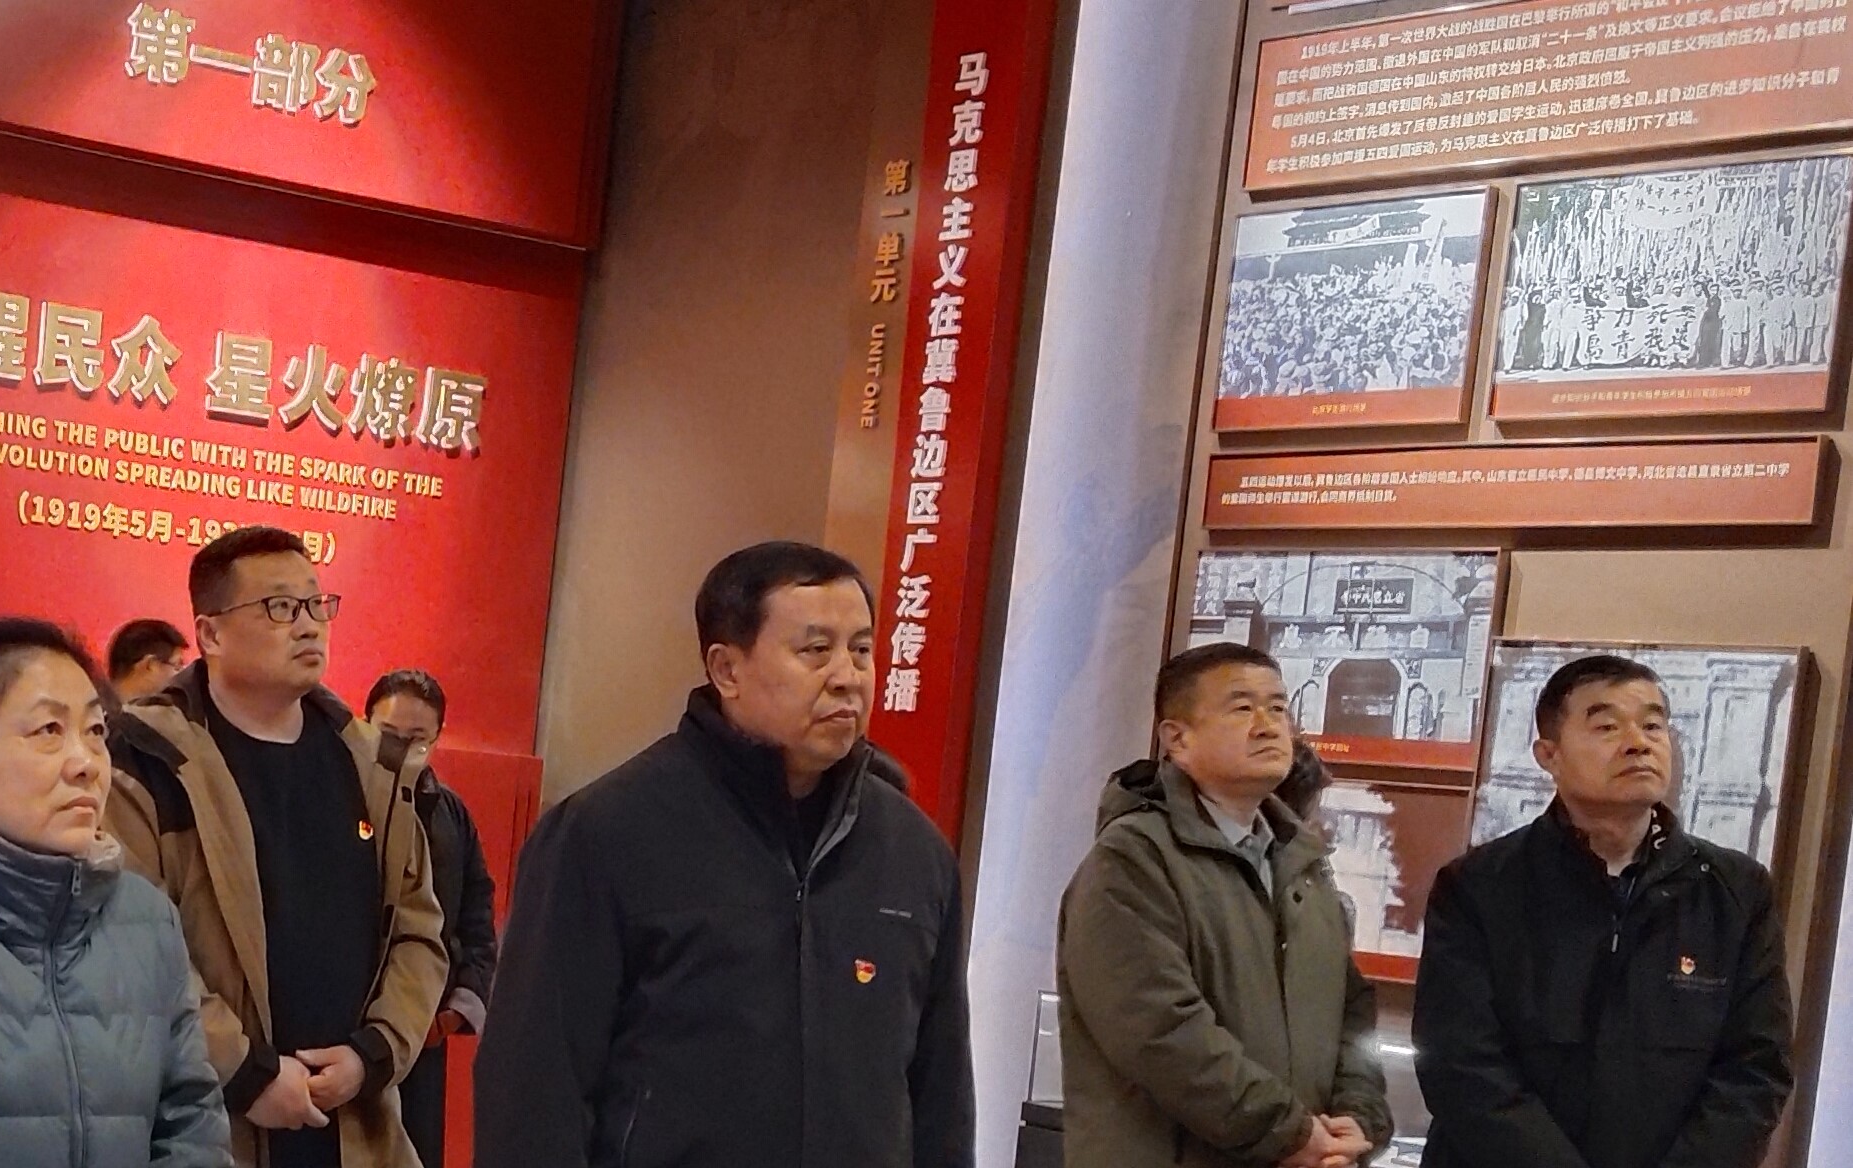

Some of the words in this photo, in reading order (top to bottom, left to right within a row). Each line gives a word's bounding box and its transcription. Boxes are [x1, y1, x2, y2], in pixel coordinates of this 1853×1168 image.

[124, 2, 377, 126] 第一部分
[869, 158, 914, 303] 第一单元
[204, 329, 489, 456] 星火燎原
[864, 322, 886, 379] UNIT
[884, 52, 989, 712] 马克思主义在冀鲁边区广泛传播
[858, 382, 880, 430] ONE
[54, 420, 99, 449] THE
[104, 428, 186, 463] PUBLIC
[190, 441, 248, 473] WITH
[253, 449, 298, 478] THE
[300, 456, 368, 492] SPARK
[372, 467, 400, 493] OF
[403, 471, 443, 499] THE
[114, 459, 242, 500] SPREADING
[246, 478, 294, 506] LIKE
[299, 484, 397, 521] WILDFIRE
